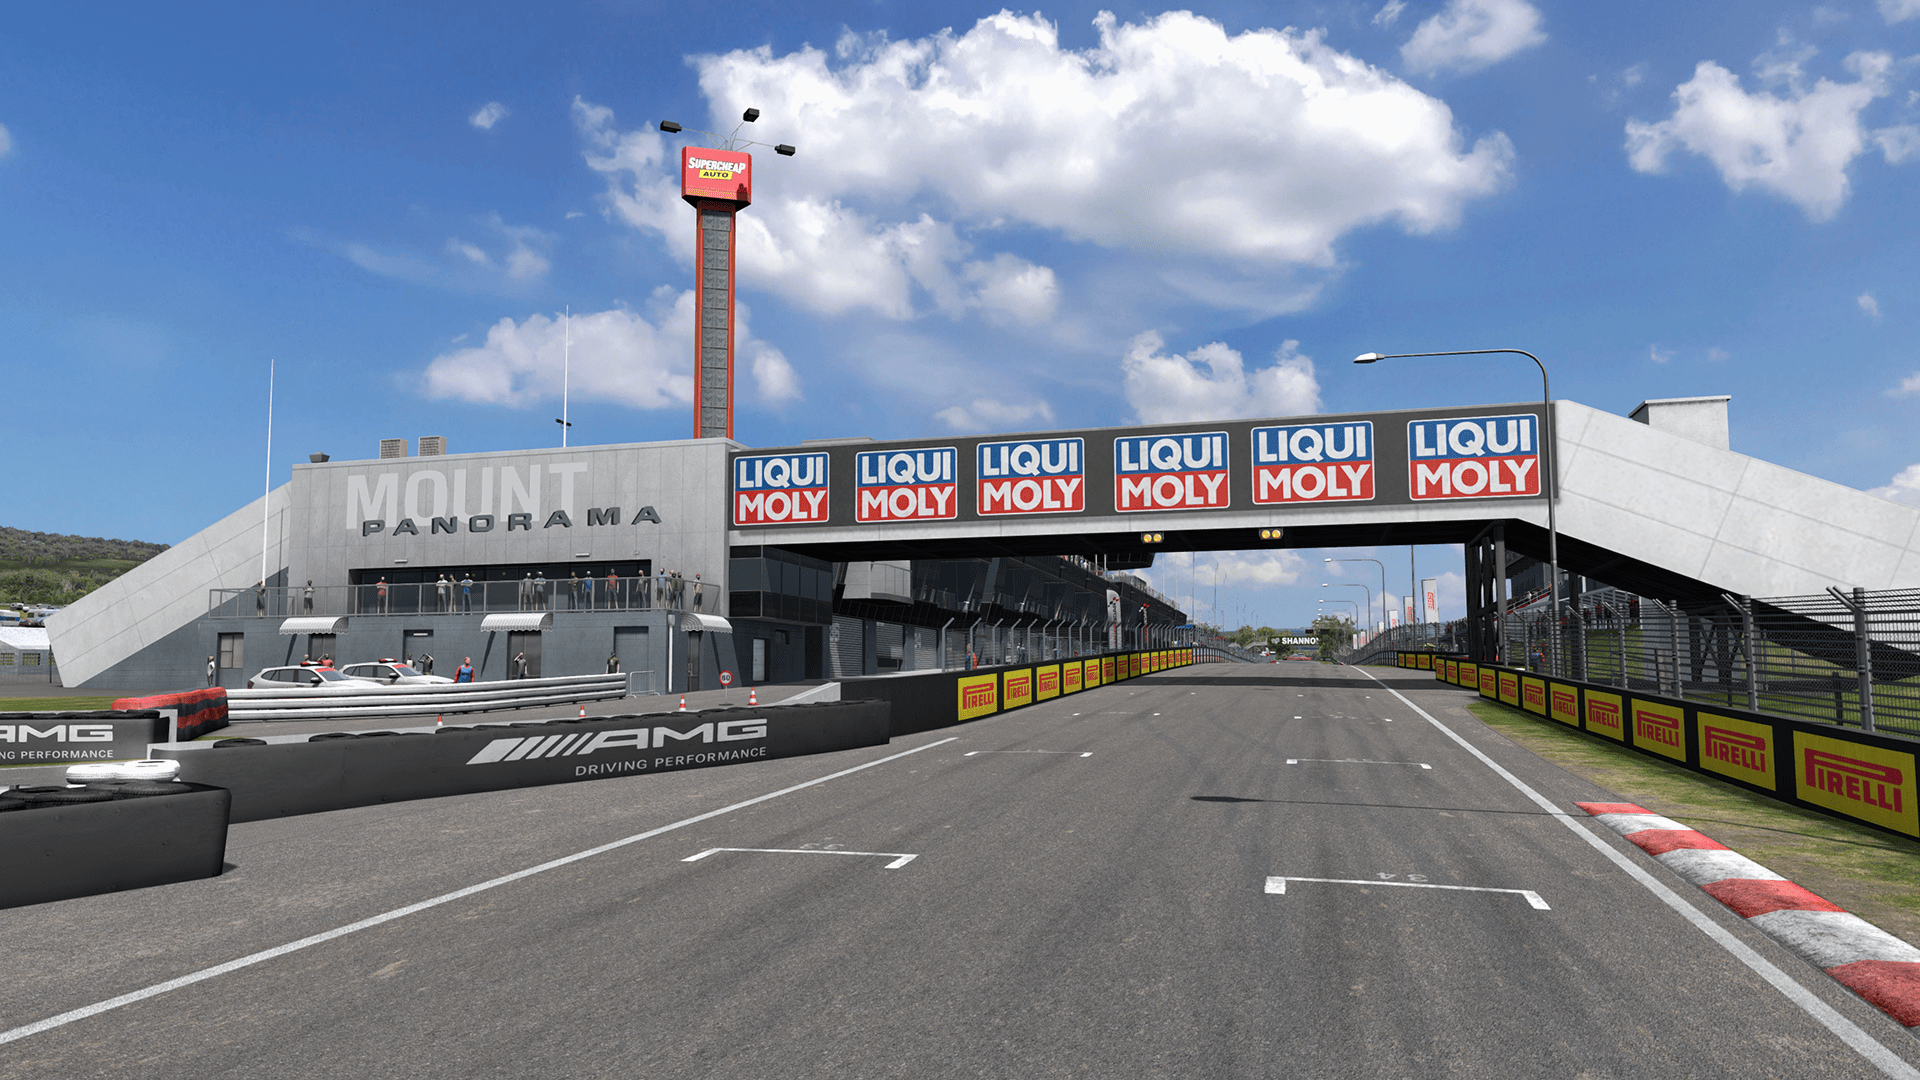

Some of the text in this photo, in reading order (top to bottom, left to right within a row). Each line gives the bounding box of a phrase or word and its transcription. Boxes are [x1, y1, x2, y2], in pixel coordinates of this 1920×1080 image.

[688, 157, 746, 174] SUPERCHEAP
[1259, 425, 1366, 462] LIQUI
[1415, 418, 1531, 456] LIQUI
[861, 451, 950, 484] LIQUI
[984, 442, 1078, 476] LIQUI
[1121, 436, 1222, 472] LIQUI
[739, 456, 824, 489] LIQUI
[1259, 463, 1371, 500] MOLY
[1416, 458, 1536, 496] MOLY
[346, 462, 588, 529] MOUNT
[739, 490, 827, 522] MOLY
[861, 486, 955, 519] MOLY
[983, 477, 1082, 511] MOLY
[1121, 473, 1227, 508] MOLY
[363, 505, 662, 537] PANORAMA
[963, 682, 994, 710] PIRELLI
[1007, 676, 1029, 701] PIRELLI
[1525, 683, 1544, 707] PIRELLI
[1553, 690, 1576, 717] PIRELLI
[1588, 698, 1620, 730] PIRELLI
[1636, 709, 1680, 748] PIRELLI
[0, 724, 113, 743] MG
[577, 719, 767, 755] AMG
[1704, 725, 1766, 773] PIRELLI
[20, 749, 114, 760] PERFORMANCE
[575, 747, 767, 776] DRIVING PERFORMANCE
[1804, 747, 1904, 814] PIRELLI
